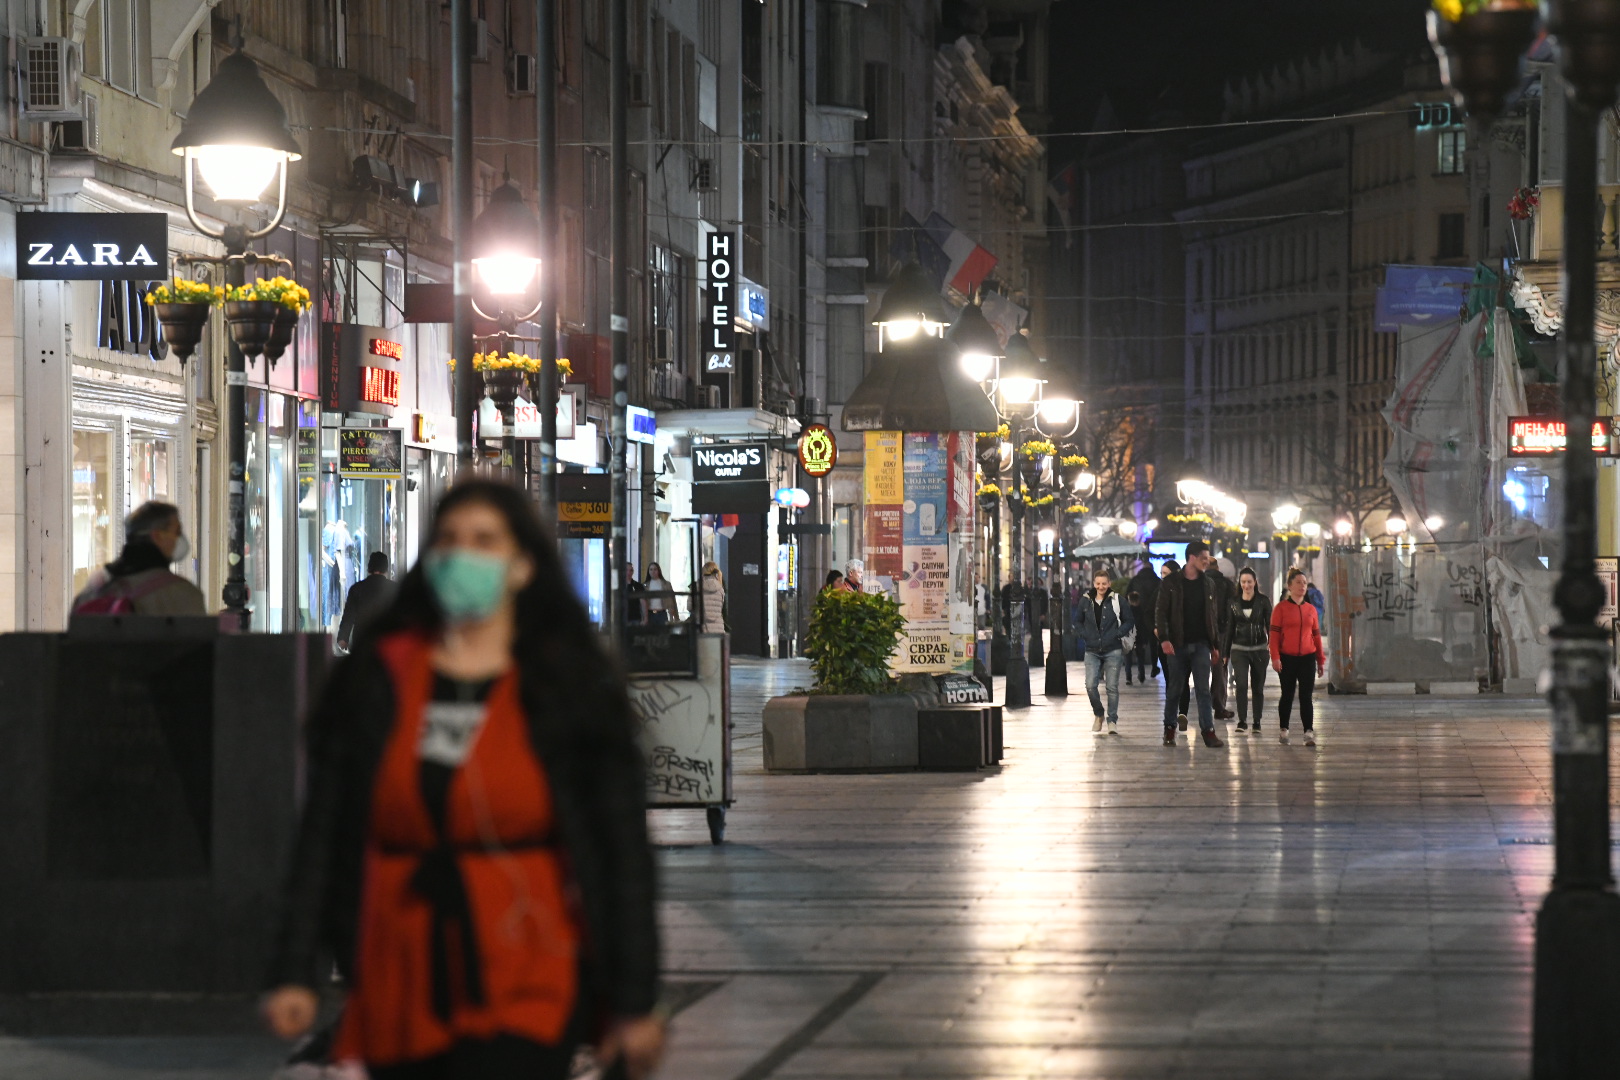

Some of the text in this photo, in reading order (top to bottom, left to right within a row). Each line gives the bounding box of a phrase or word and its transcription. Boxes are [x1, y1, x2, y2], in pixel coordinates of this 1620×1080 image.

[27, 243, 159, 267] ZARA
[711, 235, 730, 349] HOTEL
[330, 324, 342, 408] MILLENNIUM
[341, 430, 383, 441] TATTOO
[921, 562, 945, 570] САПУНИ
[928, 571, 949, 579] ПРОТИВ
[922, 580, 944, 588] ПЕРУТИ
[909, 635, 942, 643] ПРОТИВ
[909, 654, 946, 665] КОЖЕ
